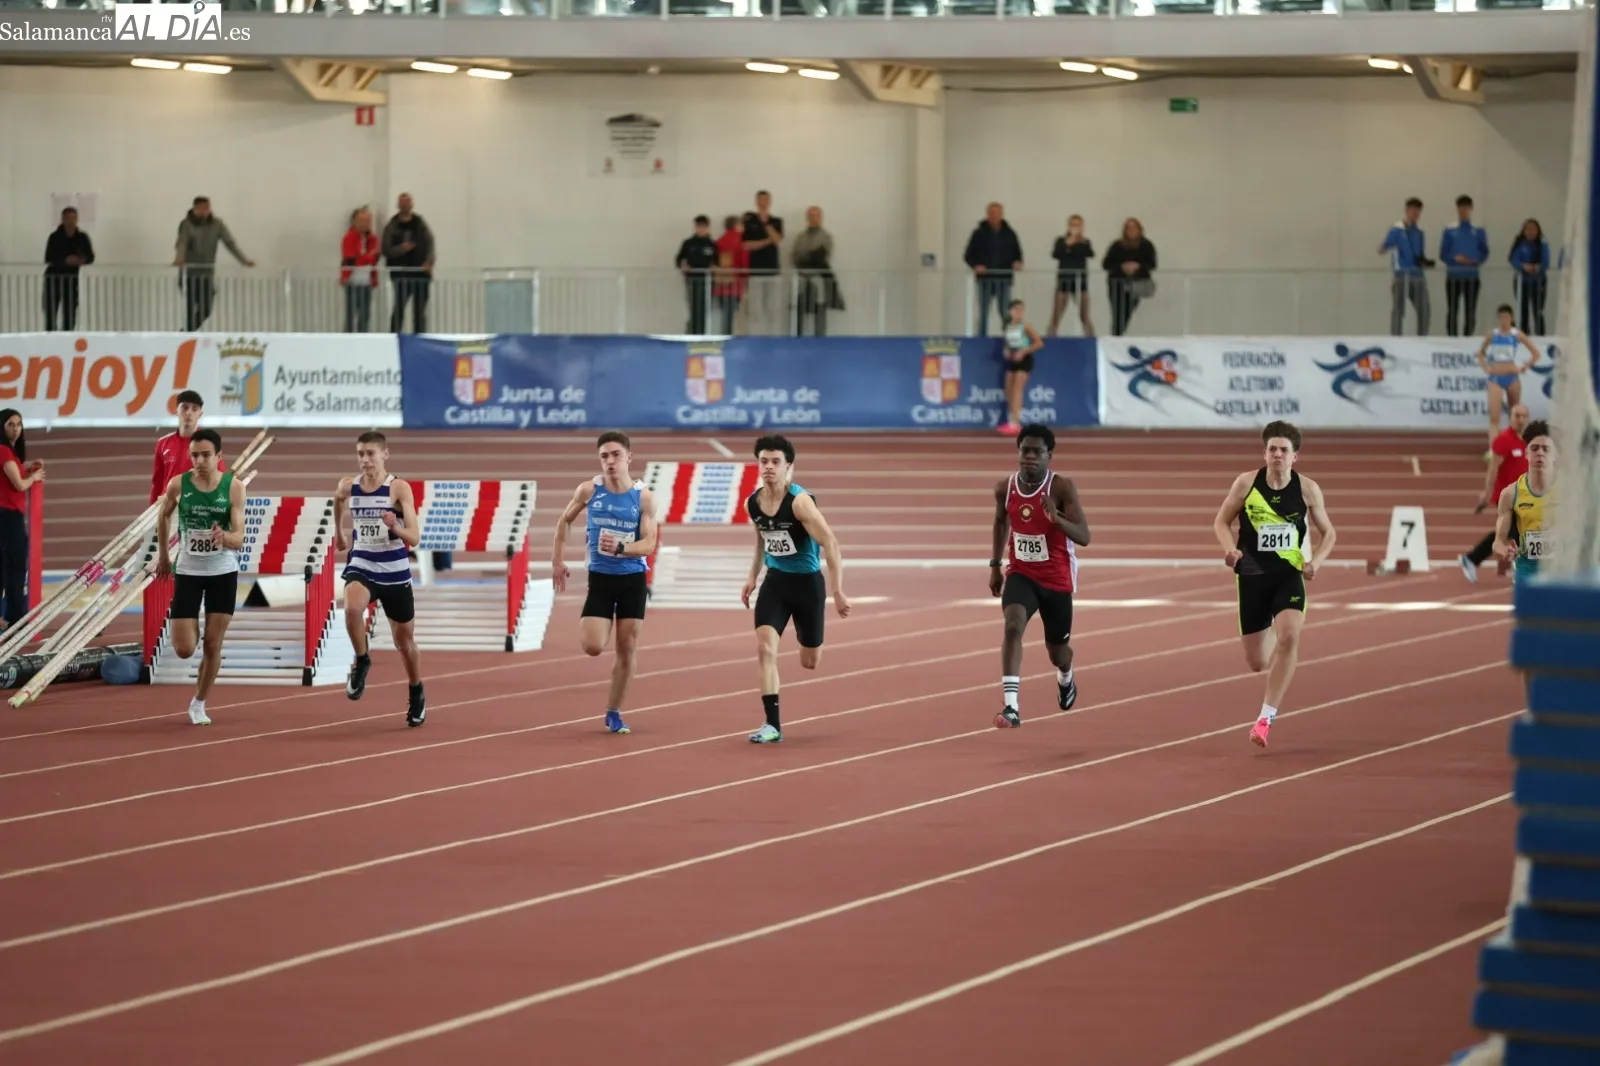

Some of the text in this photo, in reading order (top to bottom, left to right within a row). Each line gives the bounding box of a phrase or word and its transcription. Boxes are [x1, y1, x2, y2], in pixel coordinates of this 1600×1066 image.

[0, 337, 197, 416] enjoy!
[274, 365, 402, 390] Ayuntamiento
[1436, 376, 1487, 392] ATLETISM
[274, 391, 402, 412] de Salamanca
[498, 385, 586, 403] Junta de
[731, 386, 821, 404] Junta de
[966, 385, 1056, 403] Jun de
[444, 405, 586, 429] Castilla y León
[676, 405, 821, 429] Castilla y León
[911, 404, 1057, 427] Castilla y eón
[246, 498, 271, 507] NDO
[360, 525, 380, 537] 2797
[1400, 521, 1415, 548] 7
[767, 539, 790, 552] 2905
[1017, 539, 1042, 553] 2785
[1261, 533, 1290, 548] 2811
